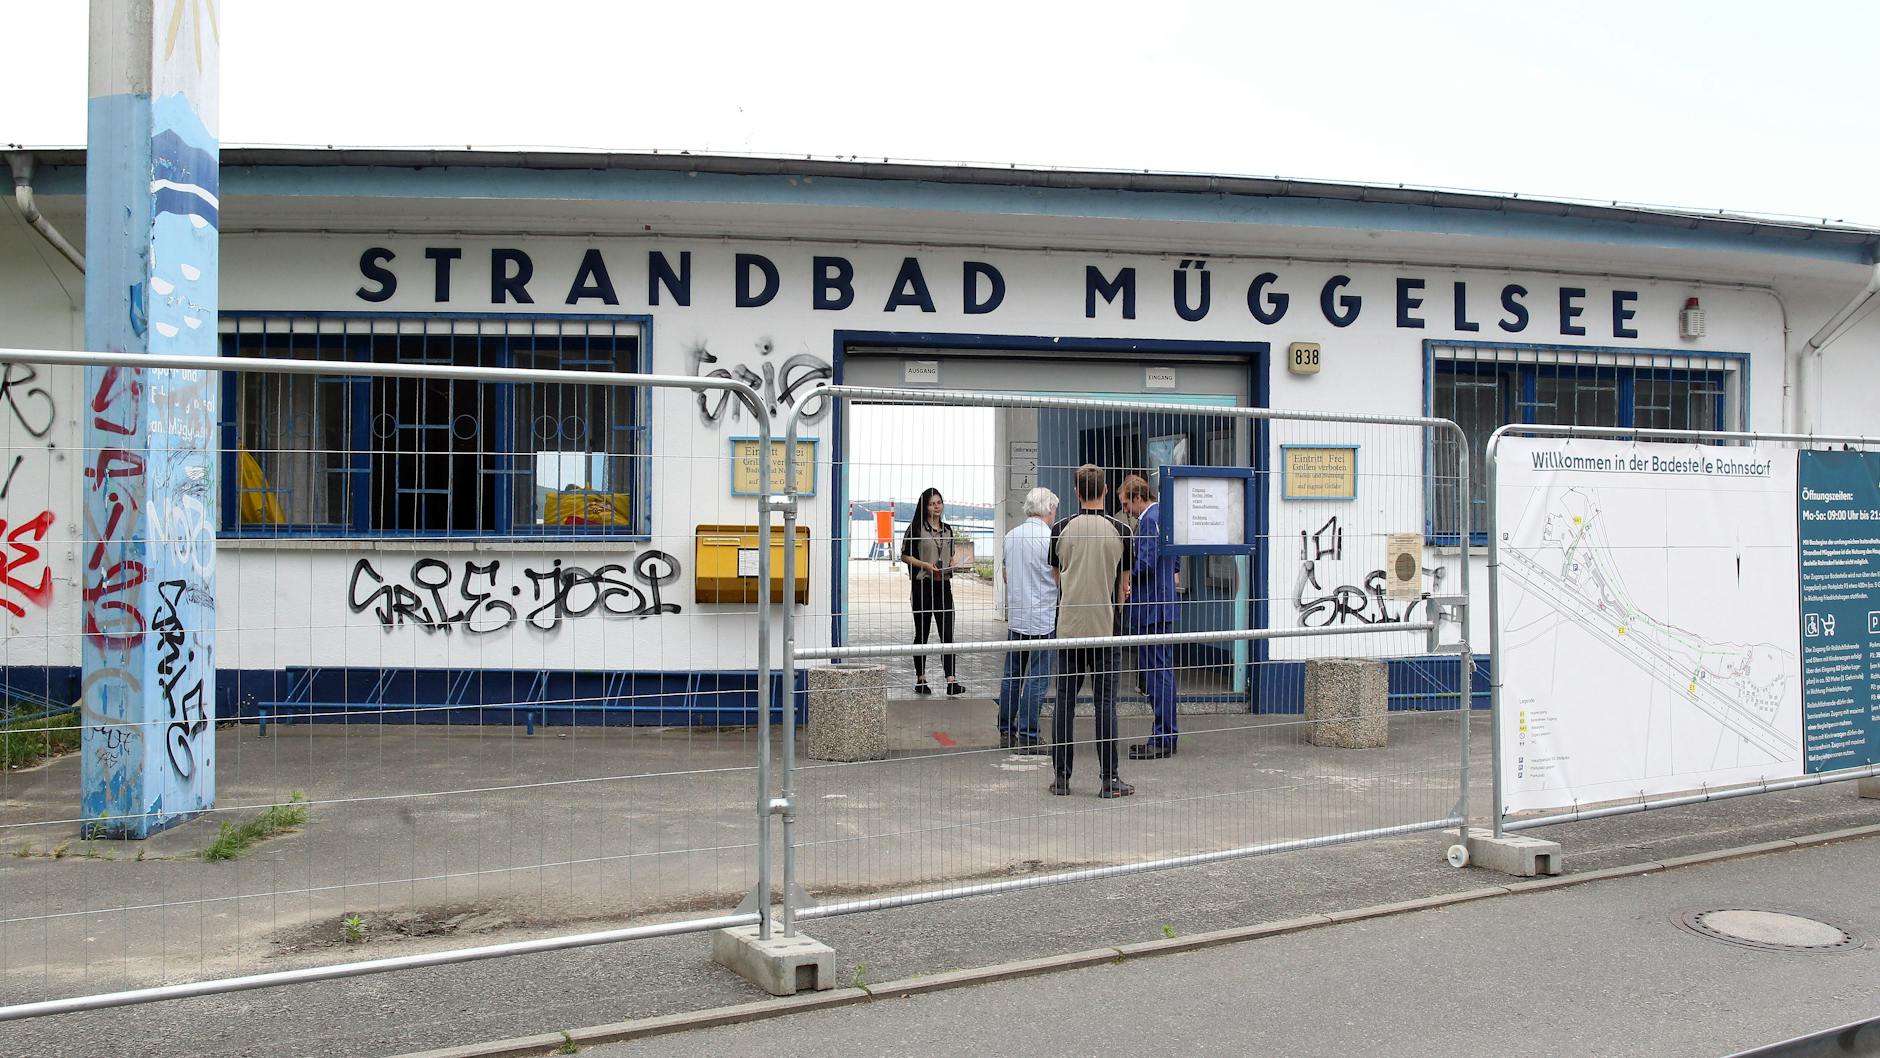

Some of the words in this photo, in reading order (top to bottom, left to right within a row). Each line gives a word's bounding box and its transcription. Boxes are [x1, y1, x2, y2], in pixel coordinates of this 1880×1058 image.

[355, 246, 1005, 316] STRANDBAD
[1085, 257, 1638, 338] MÜGGELSEE
[1295, 349, 1319, 365] 838
[1531, 451, 1611, 470] Willkommen
[1615, 454, 1625, 471] in
[1629, 454, 1649, 471] der
[1652, 456, 1713, 473] Badestelle
[1716, 458, 1771, 476] Rahnsdorf
[1802, 487, 1854, 503] Öffnungszeiten:
[1802, 510, 1826, 520] Mo-So:
[1827, 510, 1847, 520] 09:00
[1847, 510, 1859, 520] Uhr
[1860, 510, 1869, 520] bis
